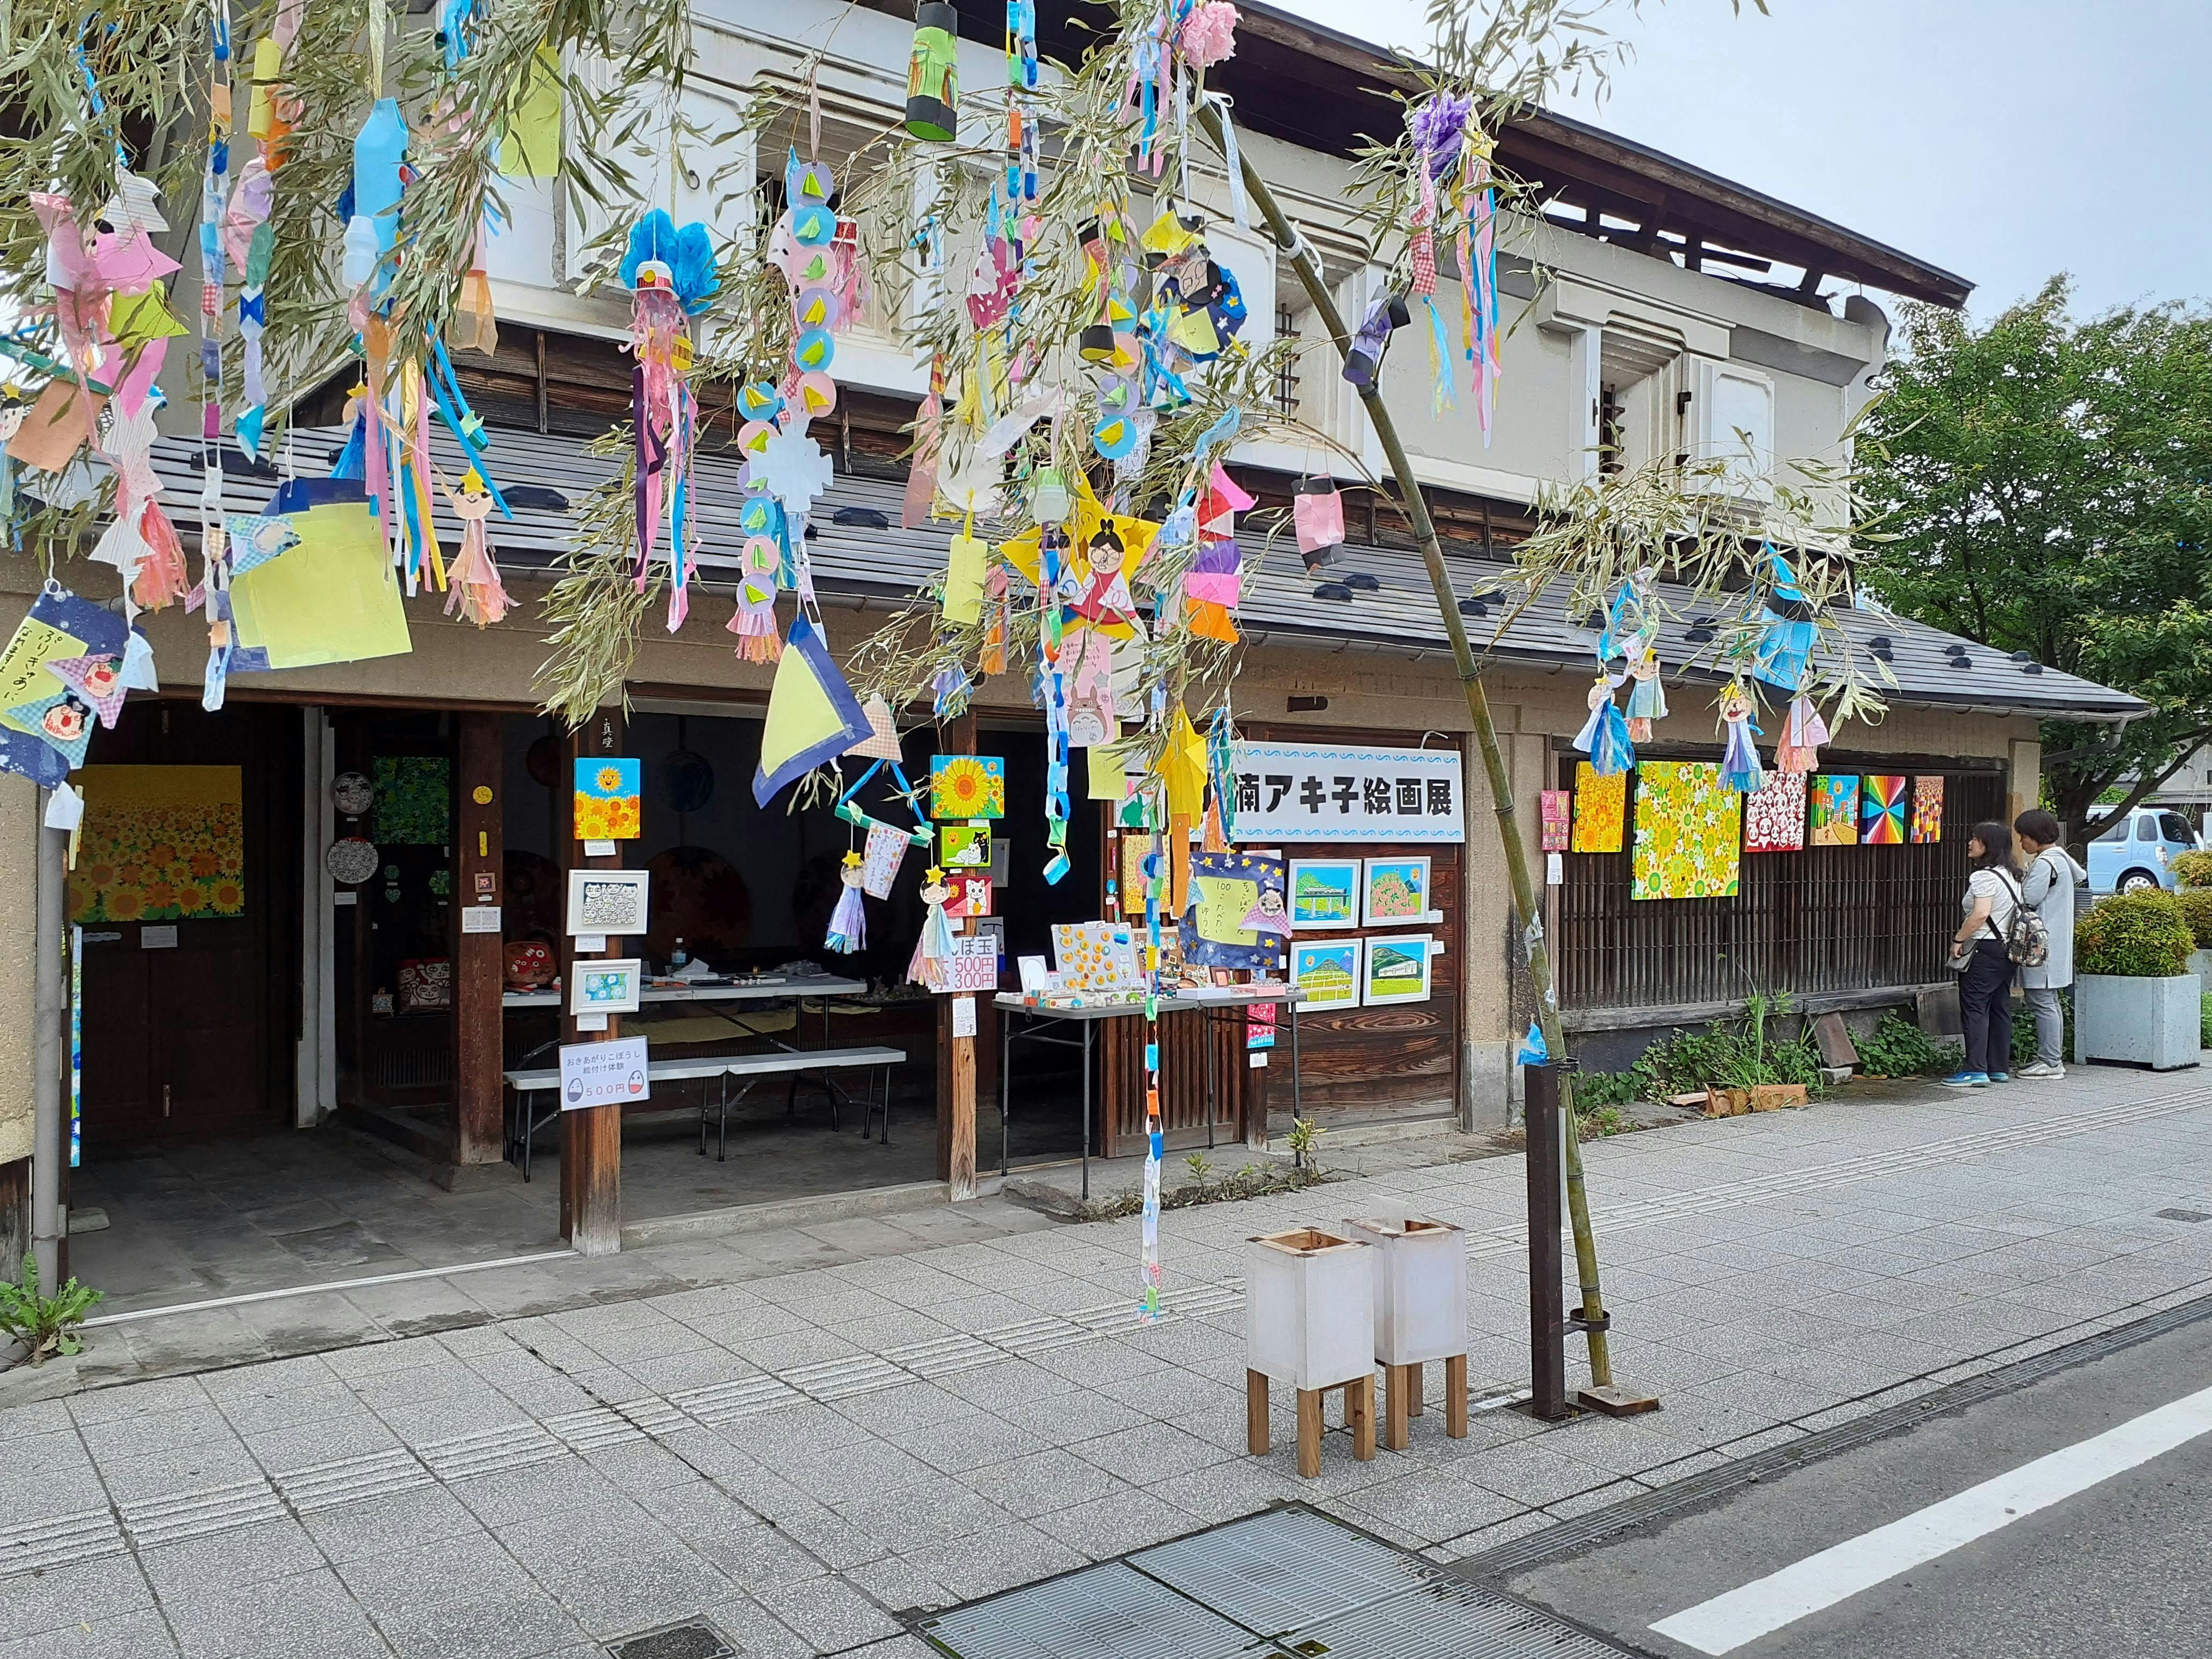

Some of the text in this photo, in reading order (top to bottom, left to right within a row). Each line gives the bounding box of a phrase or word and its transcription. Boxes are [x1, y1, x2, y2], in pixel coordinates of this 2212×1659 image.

[4, 630, 63, 701] ぷりきゅあに
[954, 956, 995, 973] 500円
[954, 973, 995, 989] 300円
[566, 1050, 640, 1067] おきあがりこぼうし
[582, 1062, 625, 1074] 絵付け体験
[586, 1083, 625, 1096] 500円
